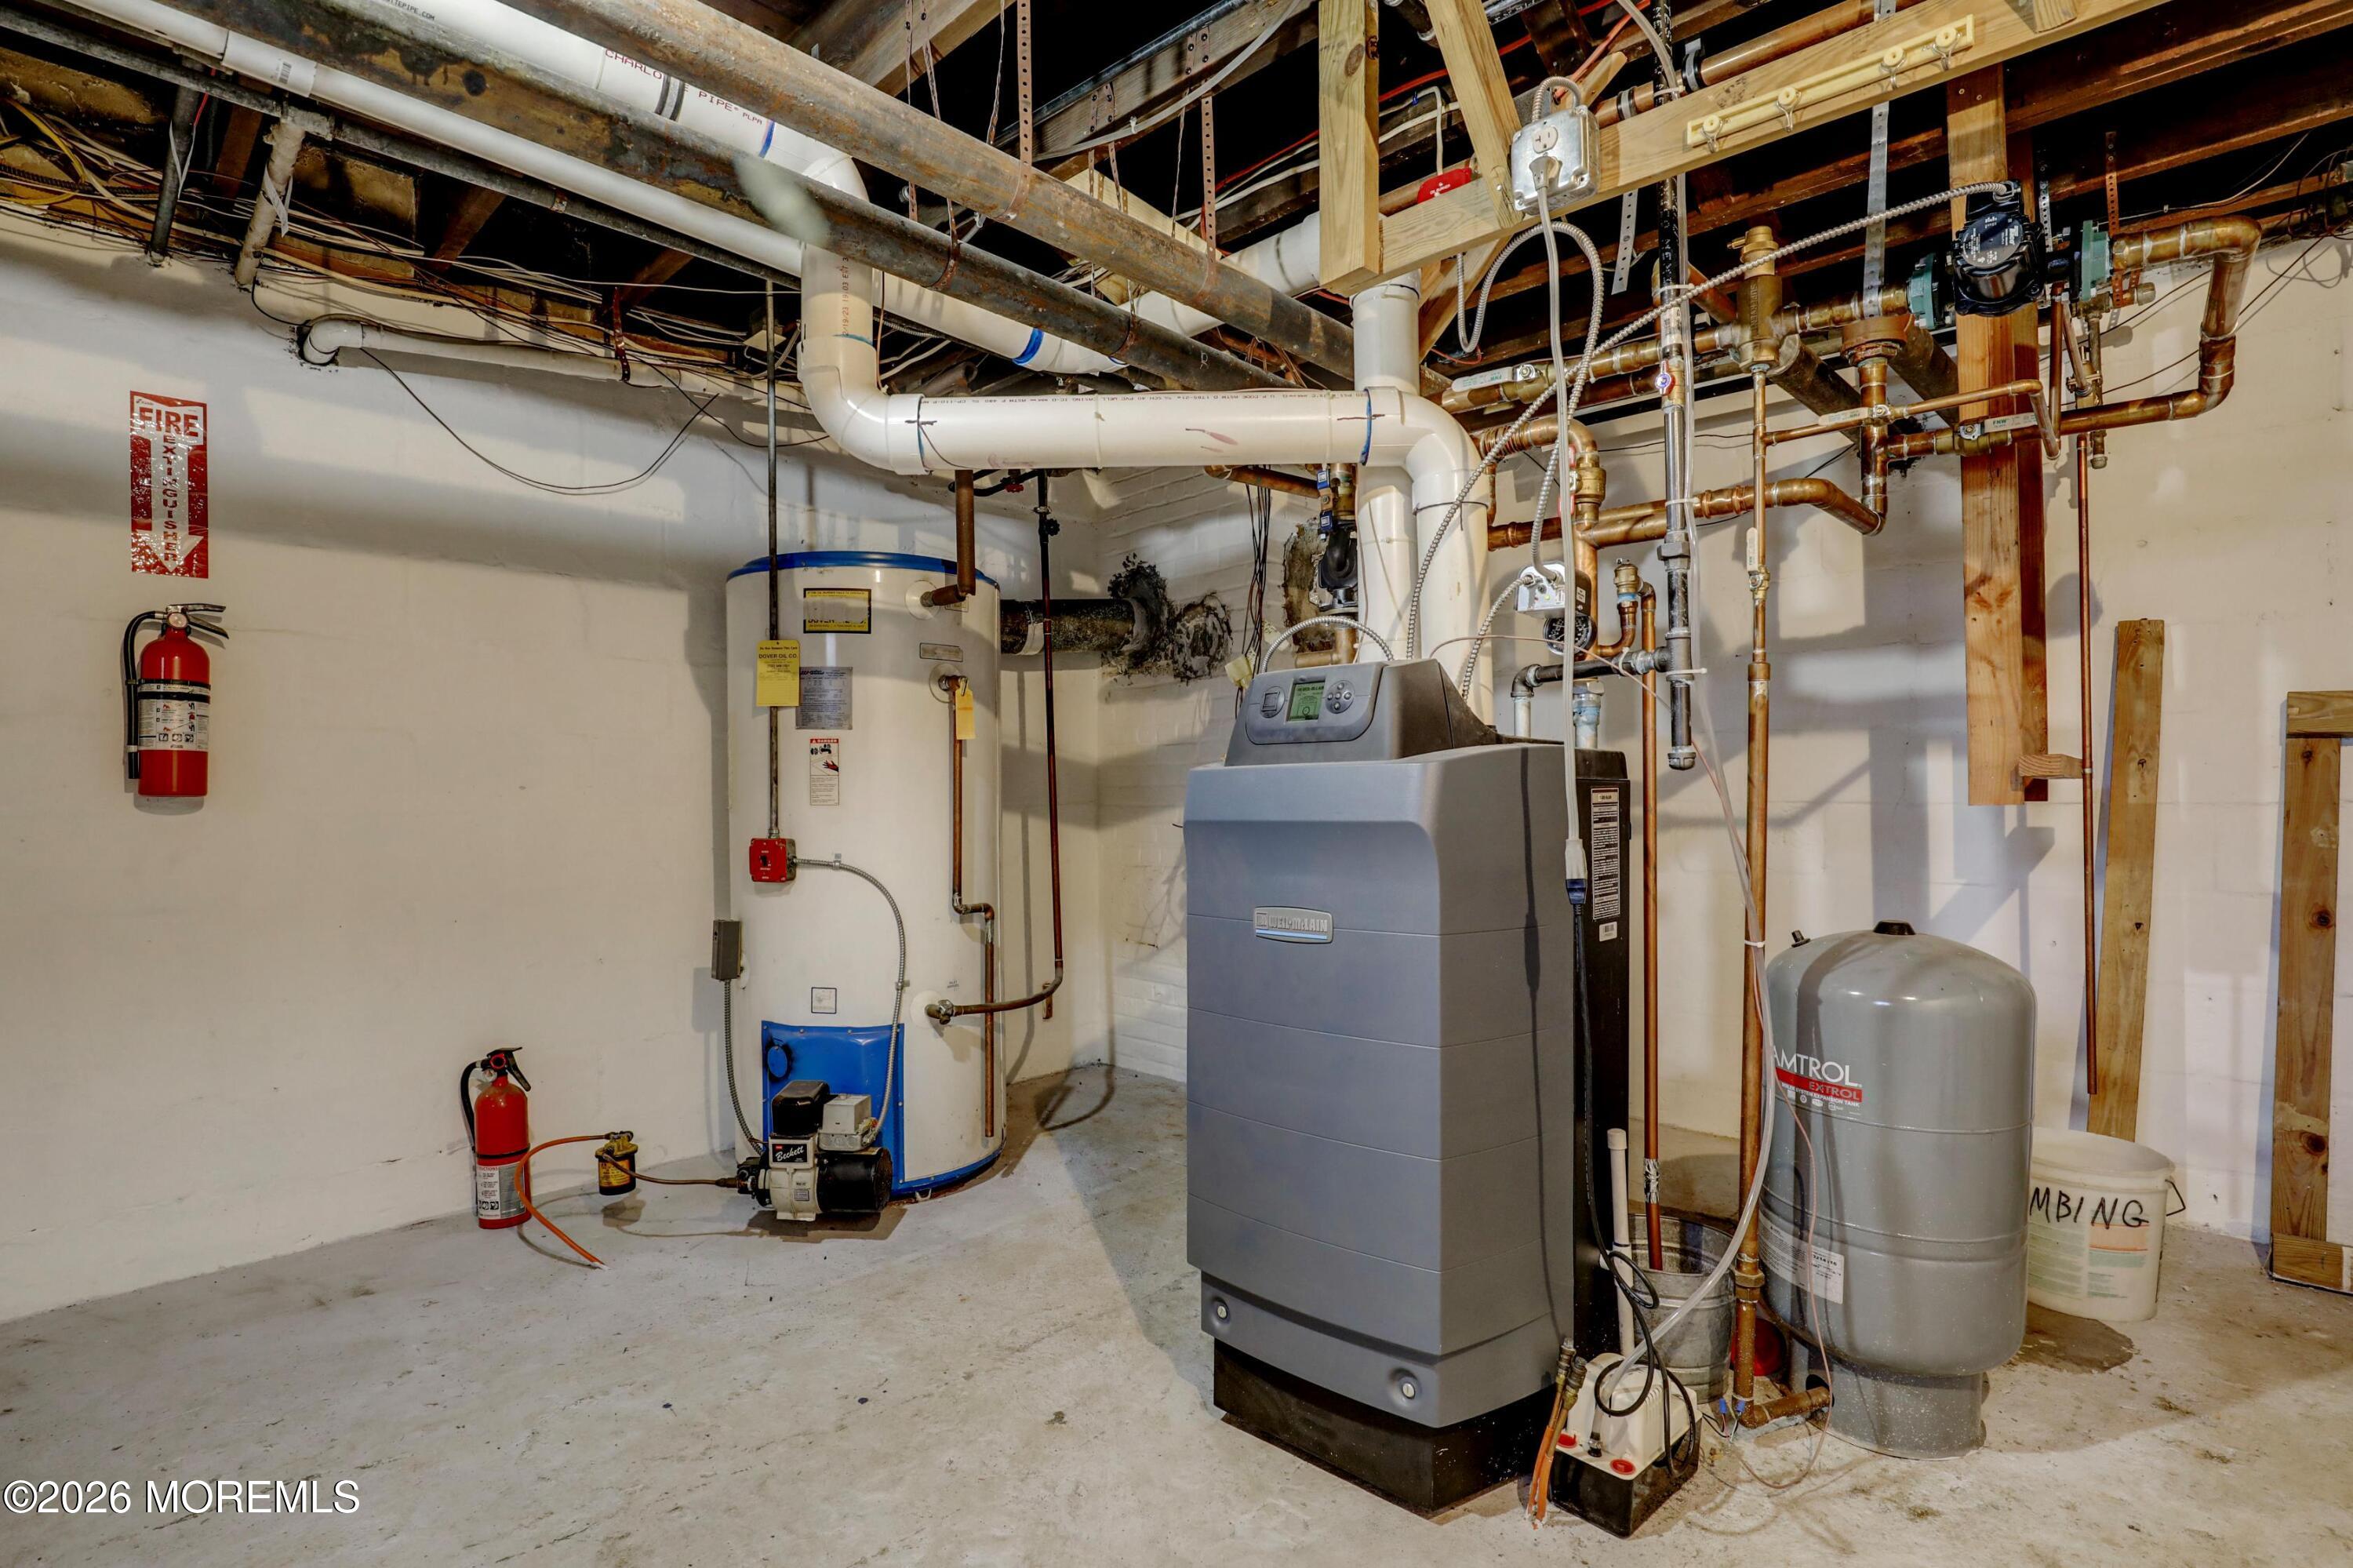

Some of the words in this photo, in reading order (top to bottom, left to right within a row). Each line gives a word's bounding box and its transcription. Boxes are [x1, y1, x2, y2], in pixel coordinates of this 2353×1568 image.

[139, 406, 198, 438] FIRE
[1808, 1081, 1860, 1101] EXTROL
[1844, 1100, 1860, 1108] TANK
[775, 1144, 805, 1162] Beckett
[2029, 1186, 2150, 1230] MBING
